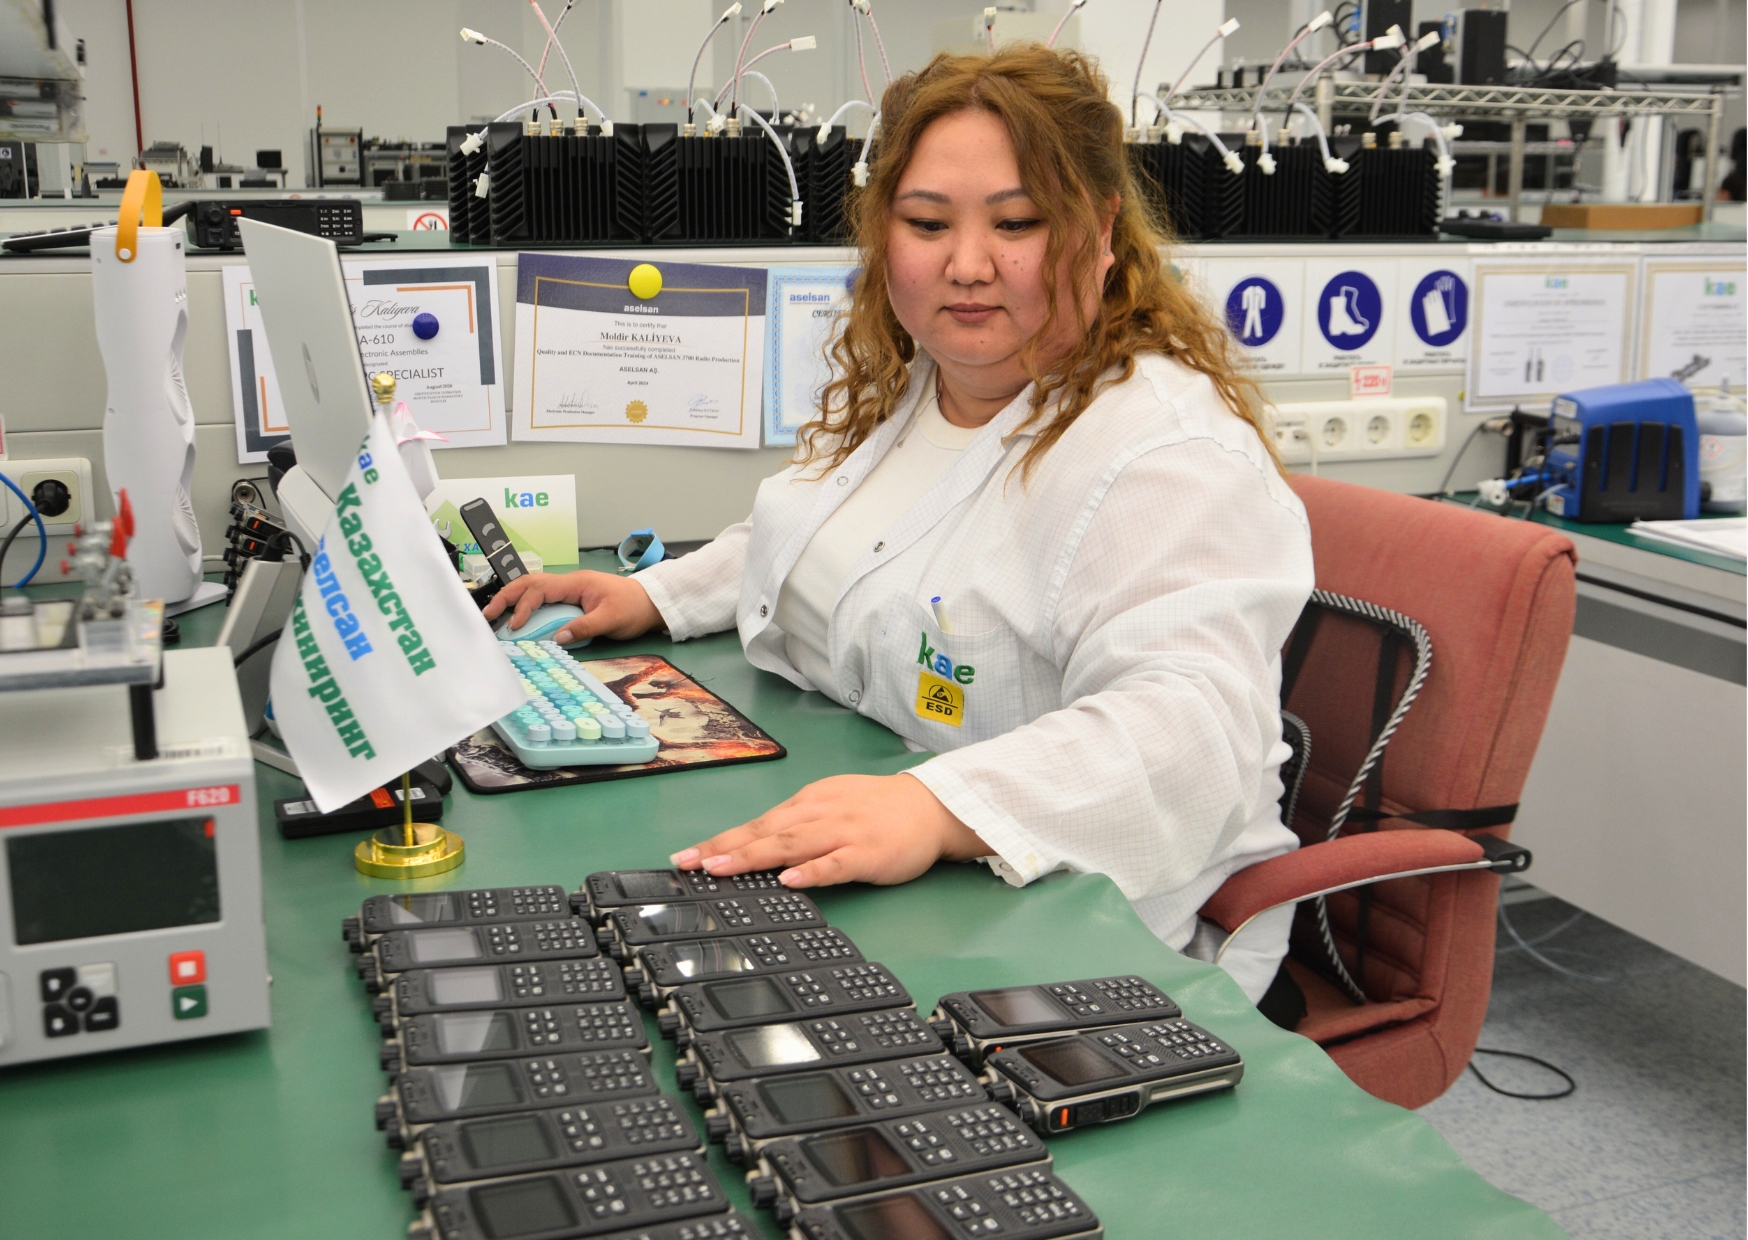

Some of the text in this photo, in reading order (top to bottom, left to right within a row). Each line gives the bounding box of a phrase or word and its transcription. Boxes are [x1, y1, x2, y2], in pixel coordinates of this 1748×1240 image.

[1704, 276, 1736, 296] kae
[789, 292, 830, 301] aselsan
[361, 299, 420, 321] Kaliyeva
[623, 304, 659, 314] aselsan
[639, 322, 656, 330] certify
[600, 332, 681, 344] Moldir KALİYEVA
[361, 348, 429, 358] ectronic Assemblies
[614, 345, 647, 354] successfully
[623, 352, 647, 360] Training
[504, 487, 550, 509] kae
[336, 481, 437, 677] Казахстан
[313, 534, 374, 662] елсан
[916, 630, 976, 685] kae
[292, 588, 377, 761] иниринг
[925, 701, 954, 716] ESD
